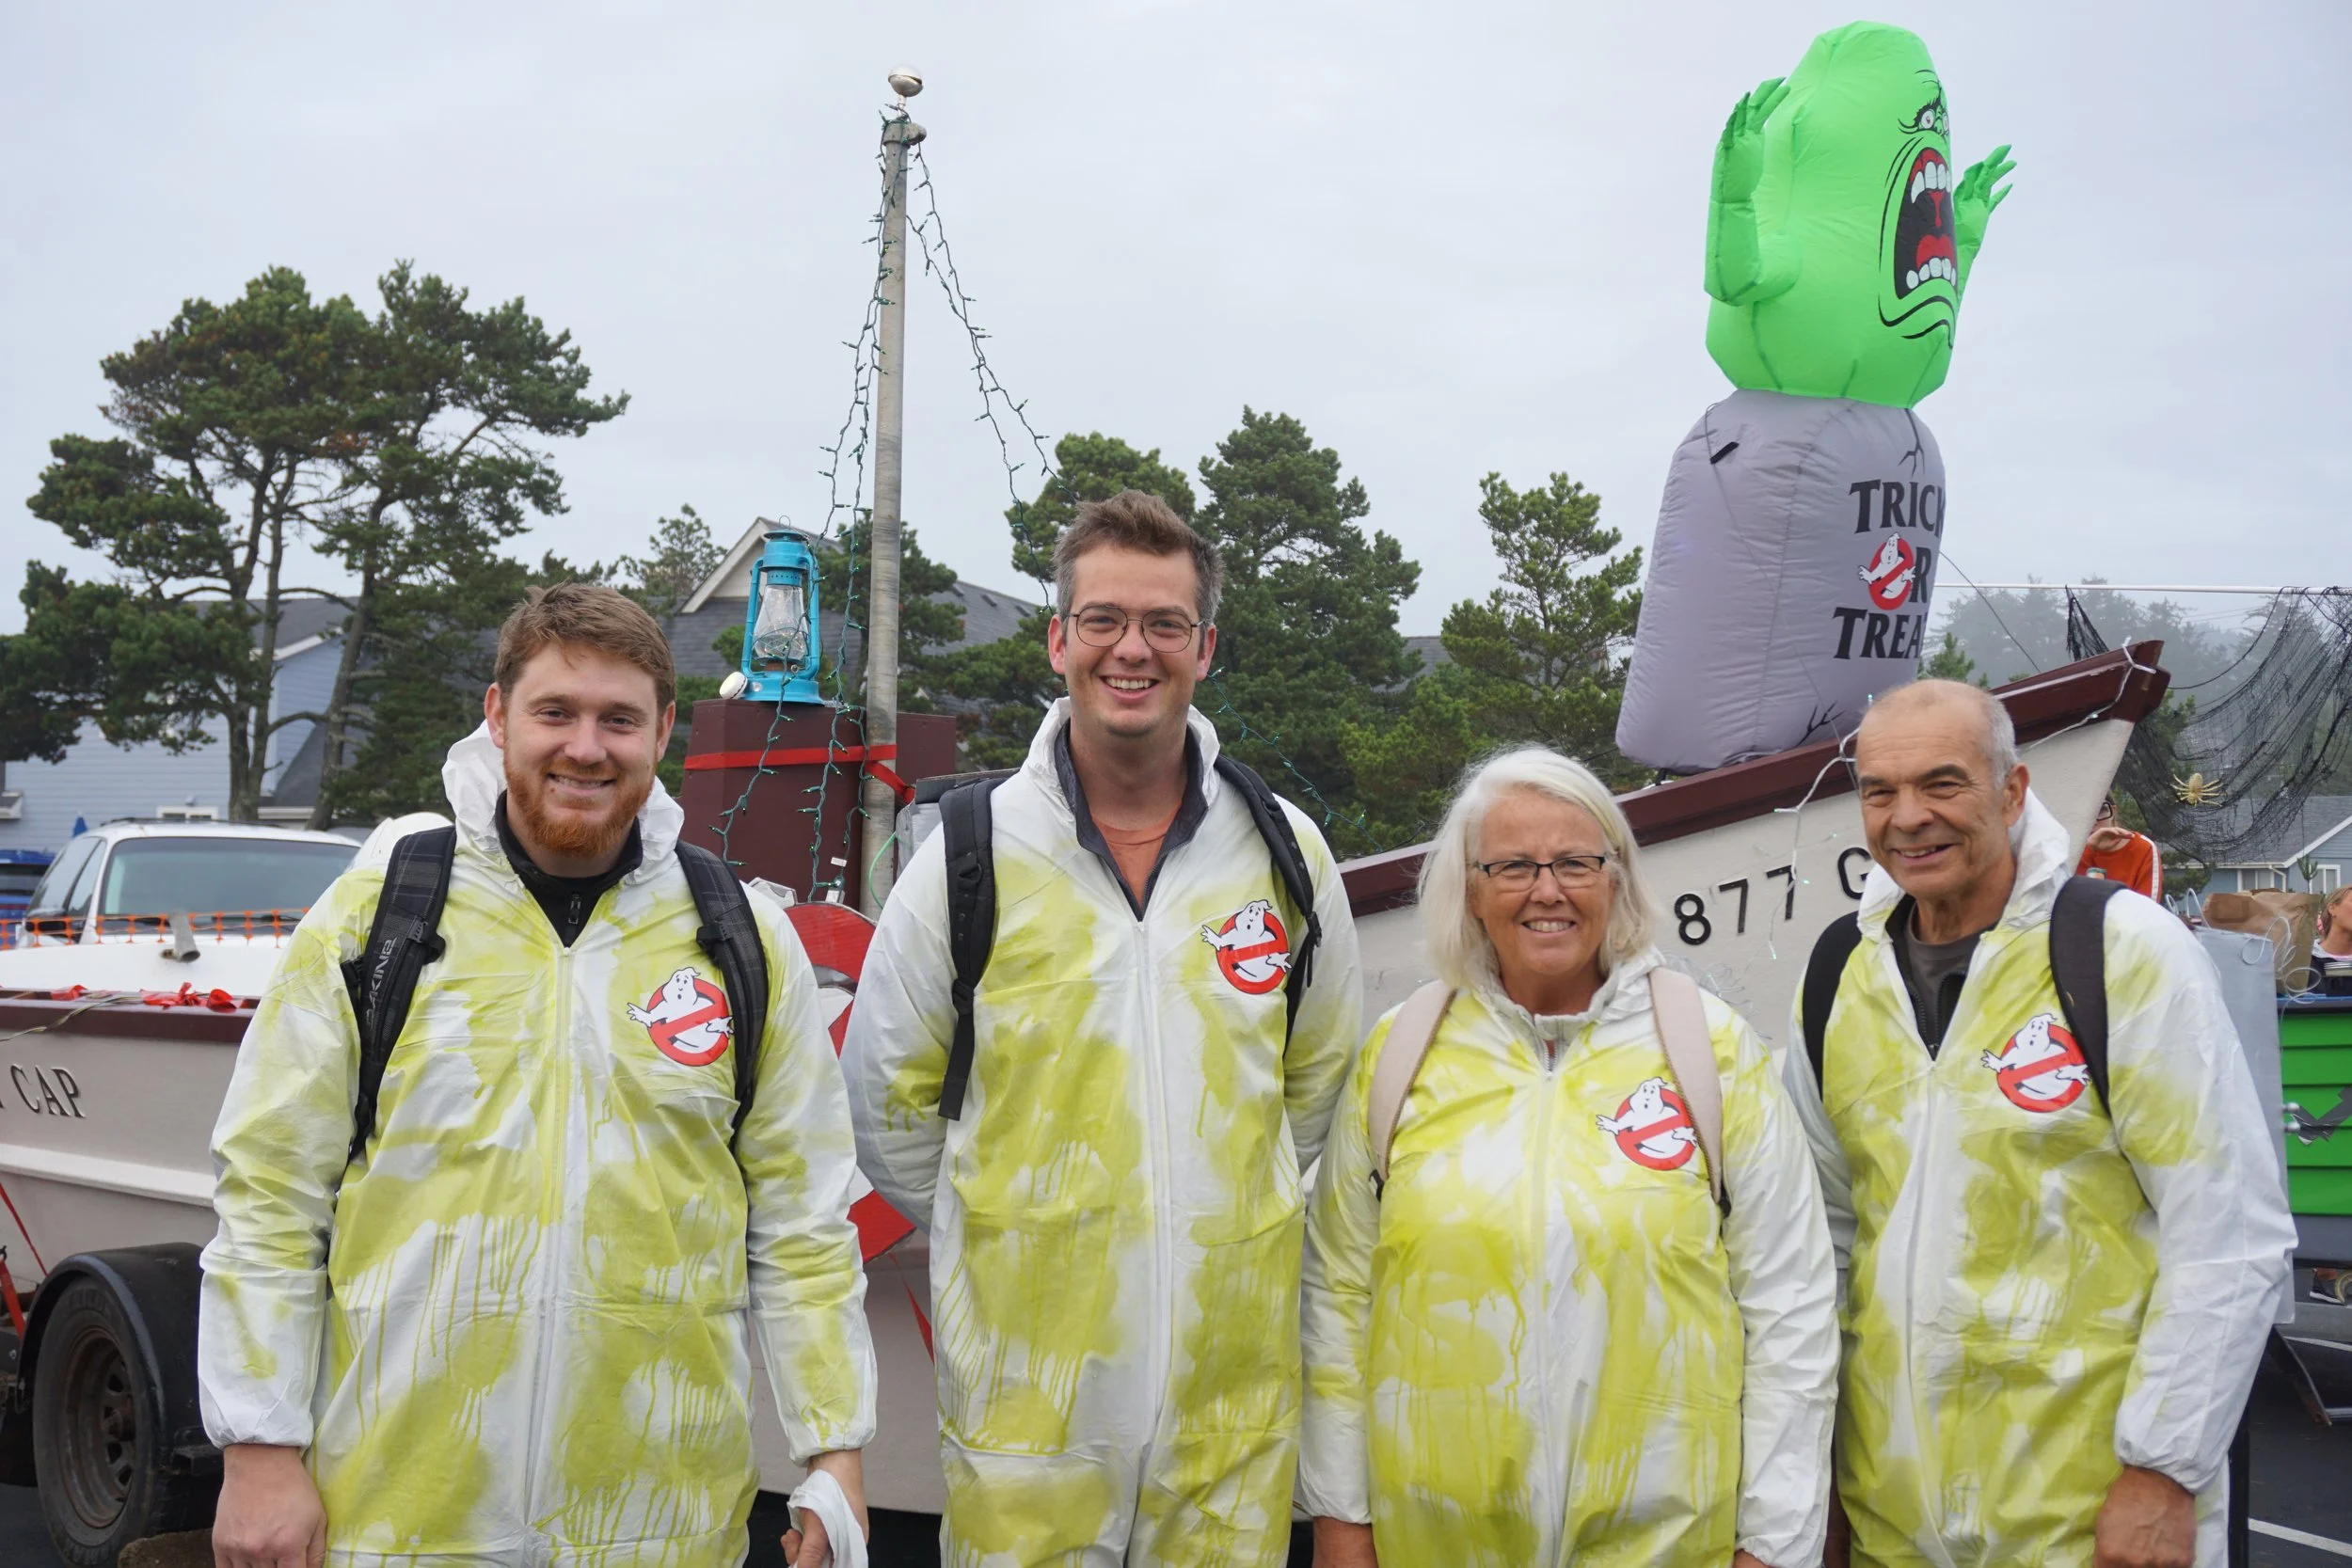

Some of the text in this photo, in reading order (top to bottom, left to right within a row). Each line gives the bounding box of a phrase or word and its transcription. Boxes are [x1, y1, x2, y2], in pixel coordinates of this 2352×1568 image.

[1833, 607, 1928, 659] TREA
[1674, 864, 1797, 945] 877
[10, 1065, 87, 1118] CAP
